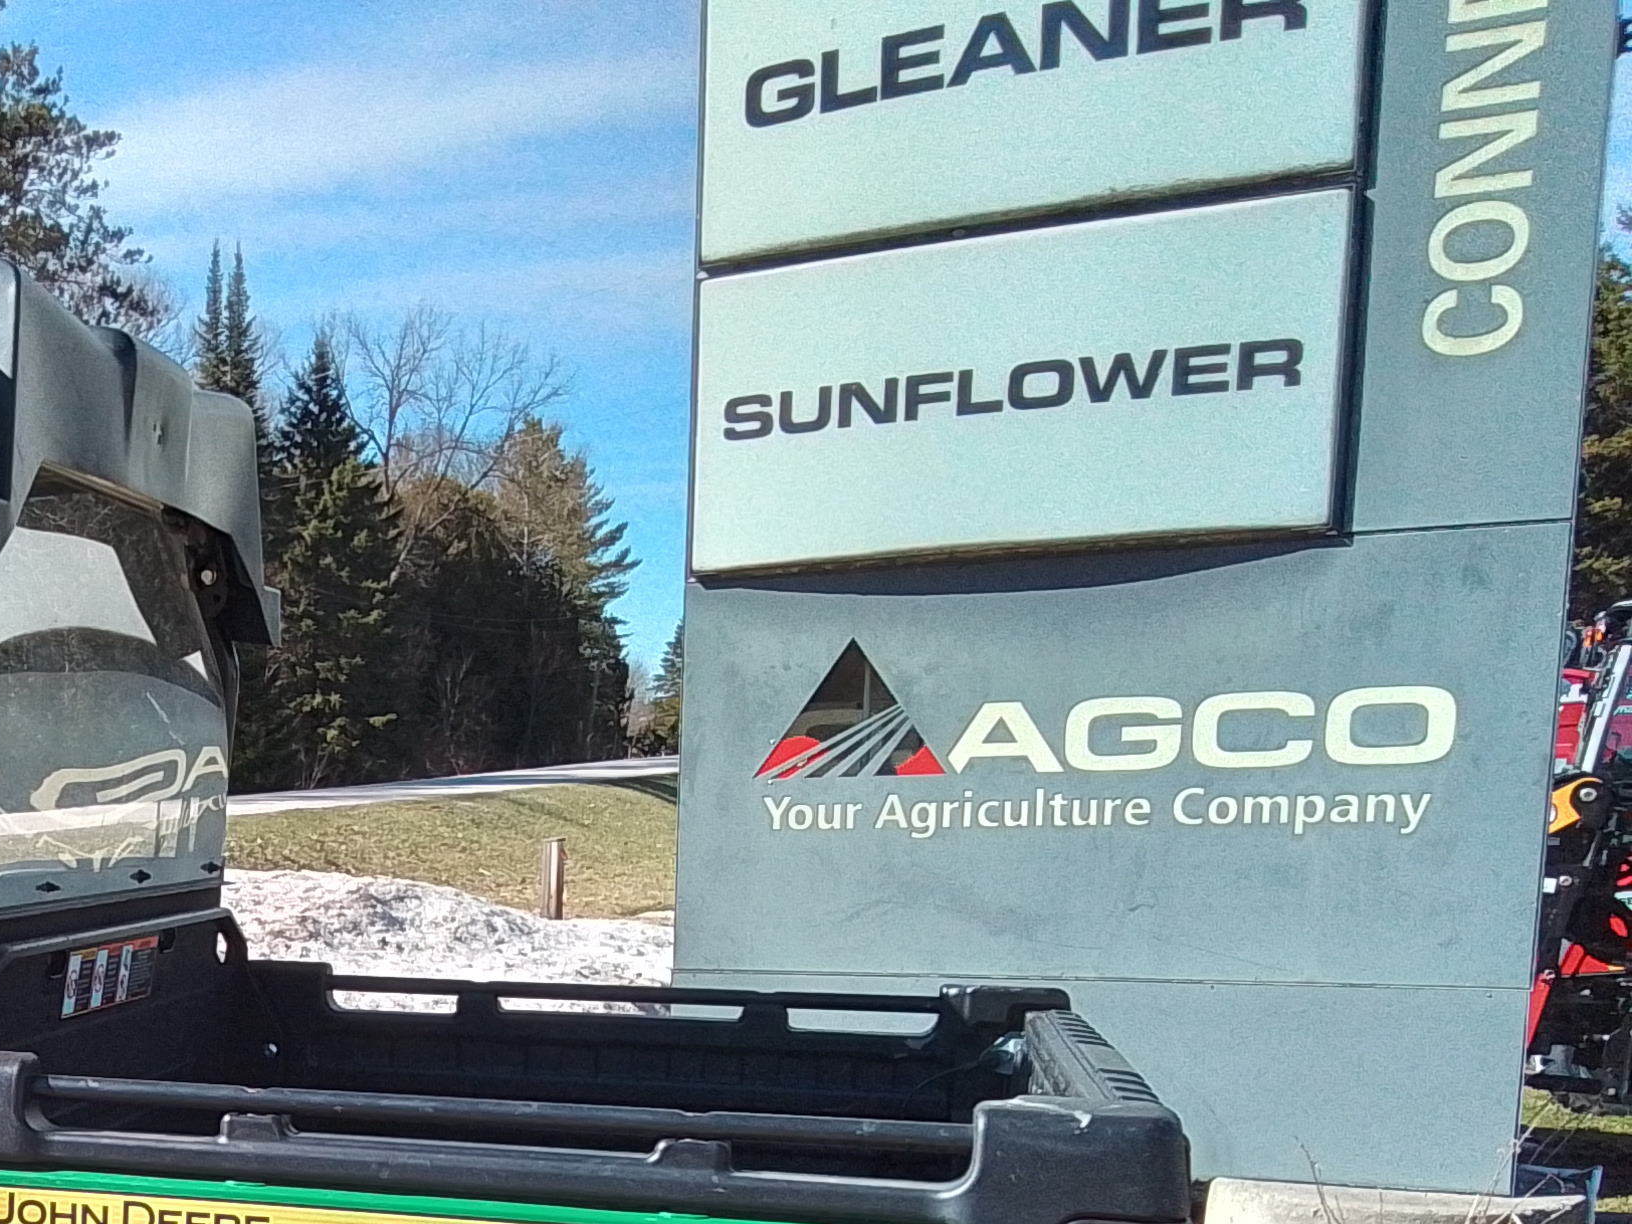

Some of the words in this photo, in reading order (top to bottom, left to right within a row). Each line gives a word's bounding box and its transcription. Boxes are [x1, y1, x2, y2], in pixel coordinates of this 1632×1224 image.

[744, 0, 1307, 128] GLEANER
[722, 337, 1305, 441] SUNFLOWER
[947, 685, 1458, 774] AGCO
[762, 795, 863, 833] Your
[873, 787, 1152, 839] Agriculture
[1172, 786, 1432, 835] Company
